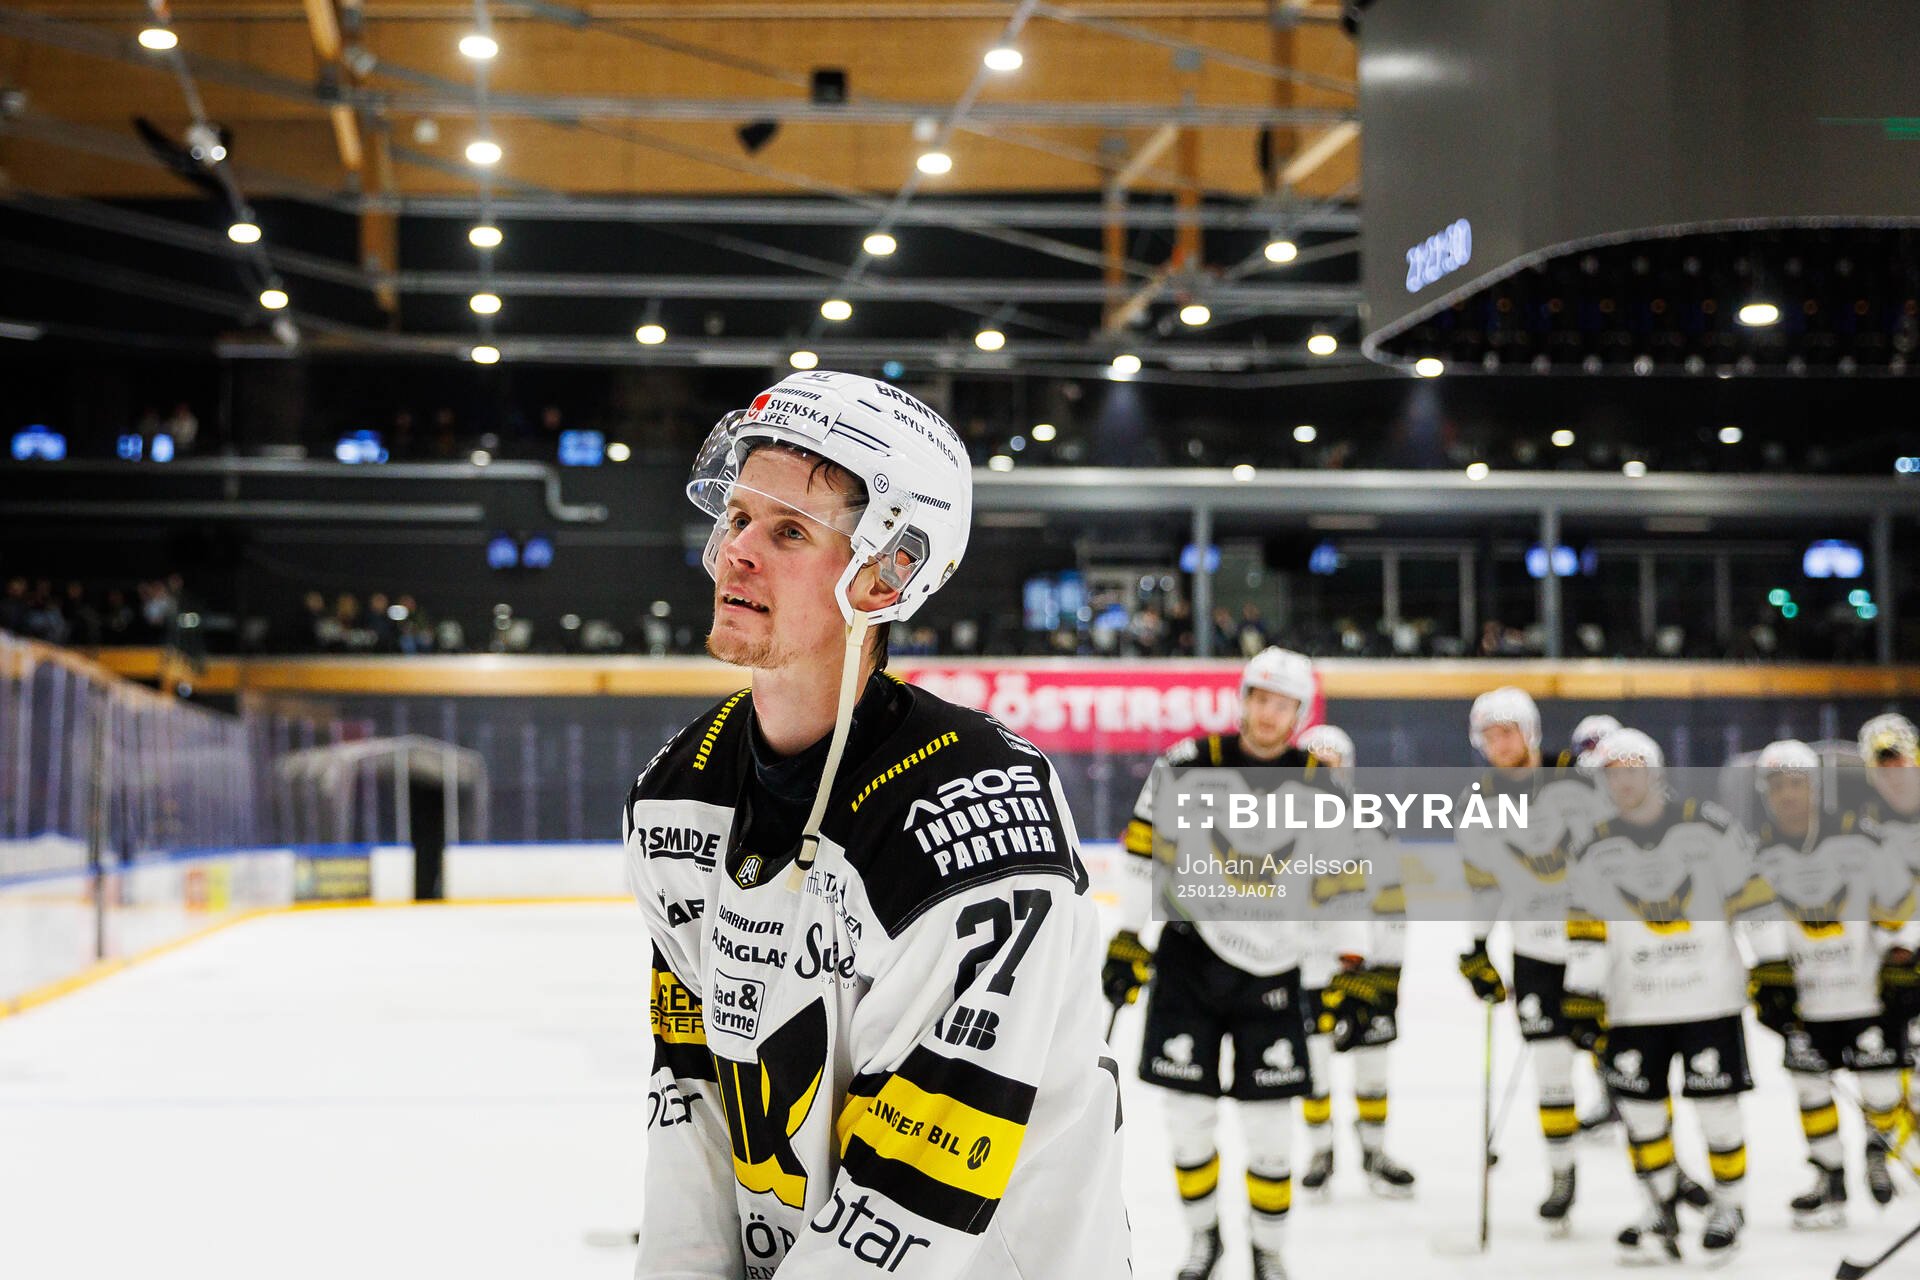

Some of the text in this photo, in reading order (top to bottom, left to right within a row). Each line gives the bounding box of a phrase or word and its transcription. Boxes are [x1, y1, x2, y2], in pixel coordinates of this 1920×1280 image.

[761, 412, 790, 426] SPEL
[768, 399, 830, 427] SVENSKA
[893, 409, 925, 435] SKYLT
[990, 673, 1240, 733] ÖSTERSU
[851, 731, 959, 812] WARRIOR
[903, 765, 1041, 832] AROS
[915, 797, 1050, 853] INDUSTRI
[933, 826, 1056, 877] PARTNER
[719, 904, 785, 936] WARRIOR
[711, 926, 788, 970] AFAGLAS
[954, 888, 1052, 997] 27
[738, 983, 758, 1013] &
[927, 1124, 961, 1157] BIL
